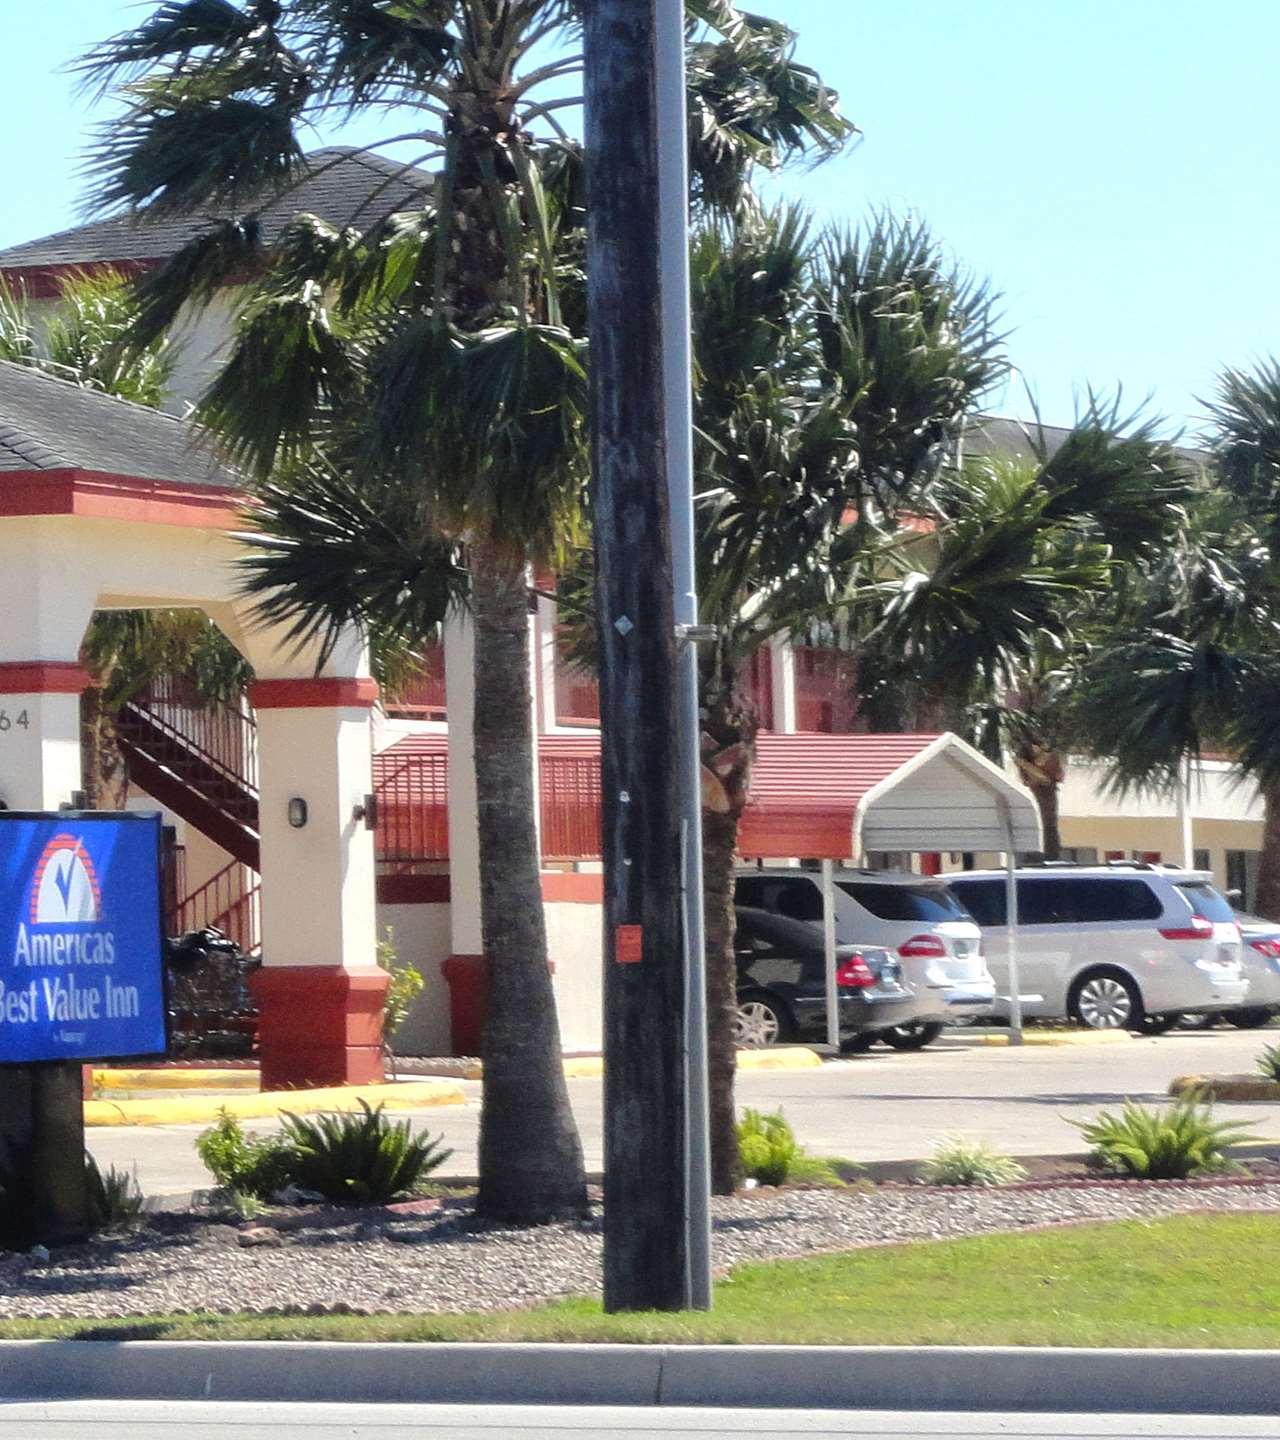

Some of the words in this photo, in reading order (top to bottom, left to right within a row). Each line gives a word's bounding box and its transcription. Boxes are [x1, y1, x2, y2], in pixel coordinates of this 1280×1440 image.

[13, 922, 115, 967] Americas
[43, 973, 100, 1022] Value
[104, 974, 139, 1018] Inn
